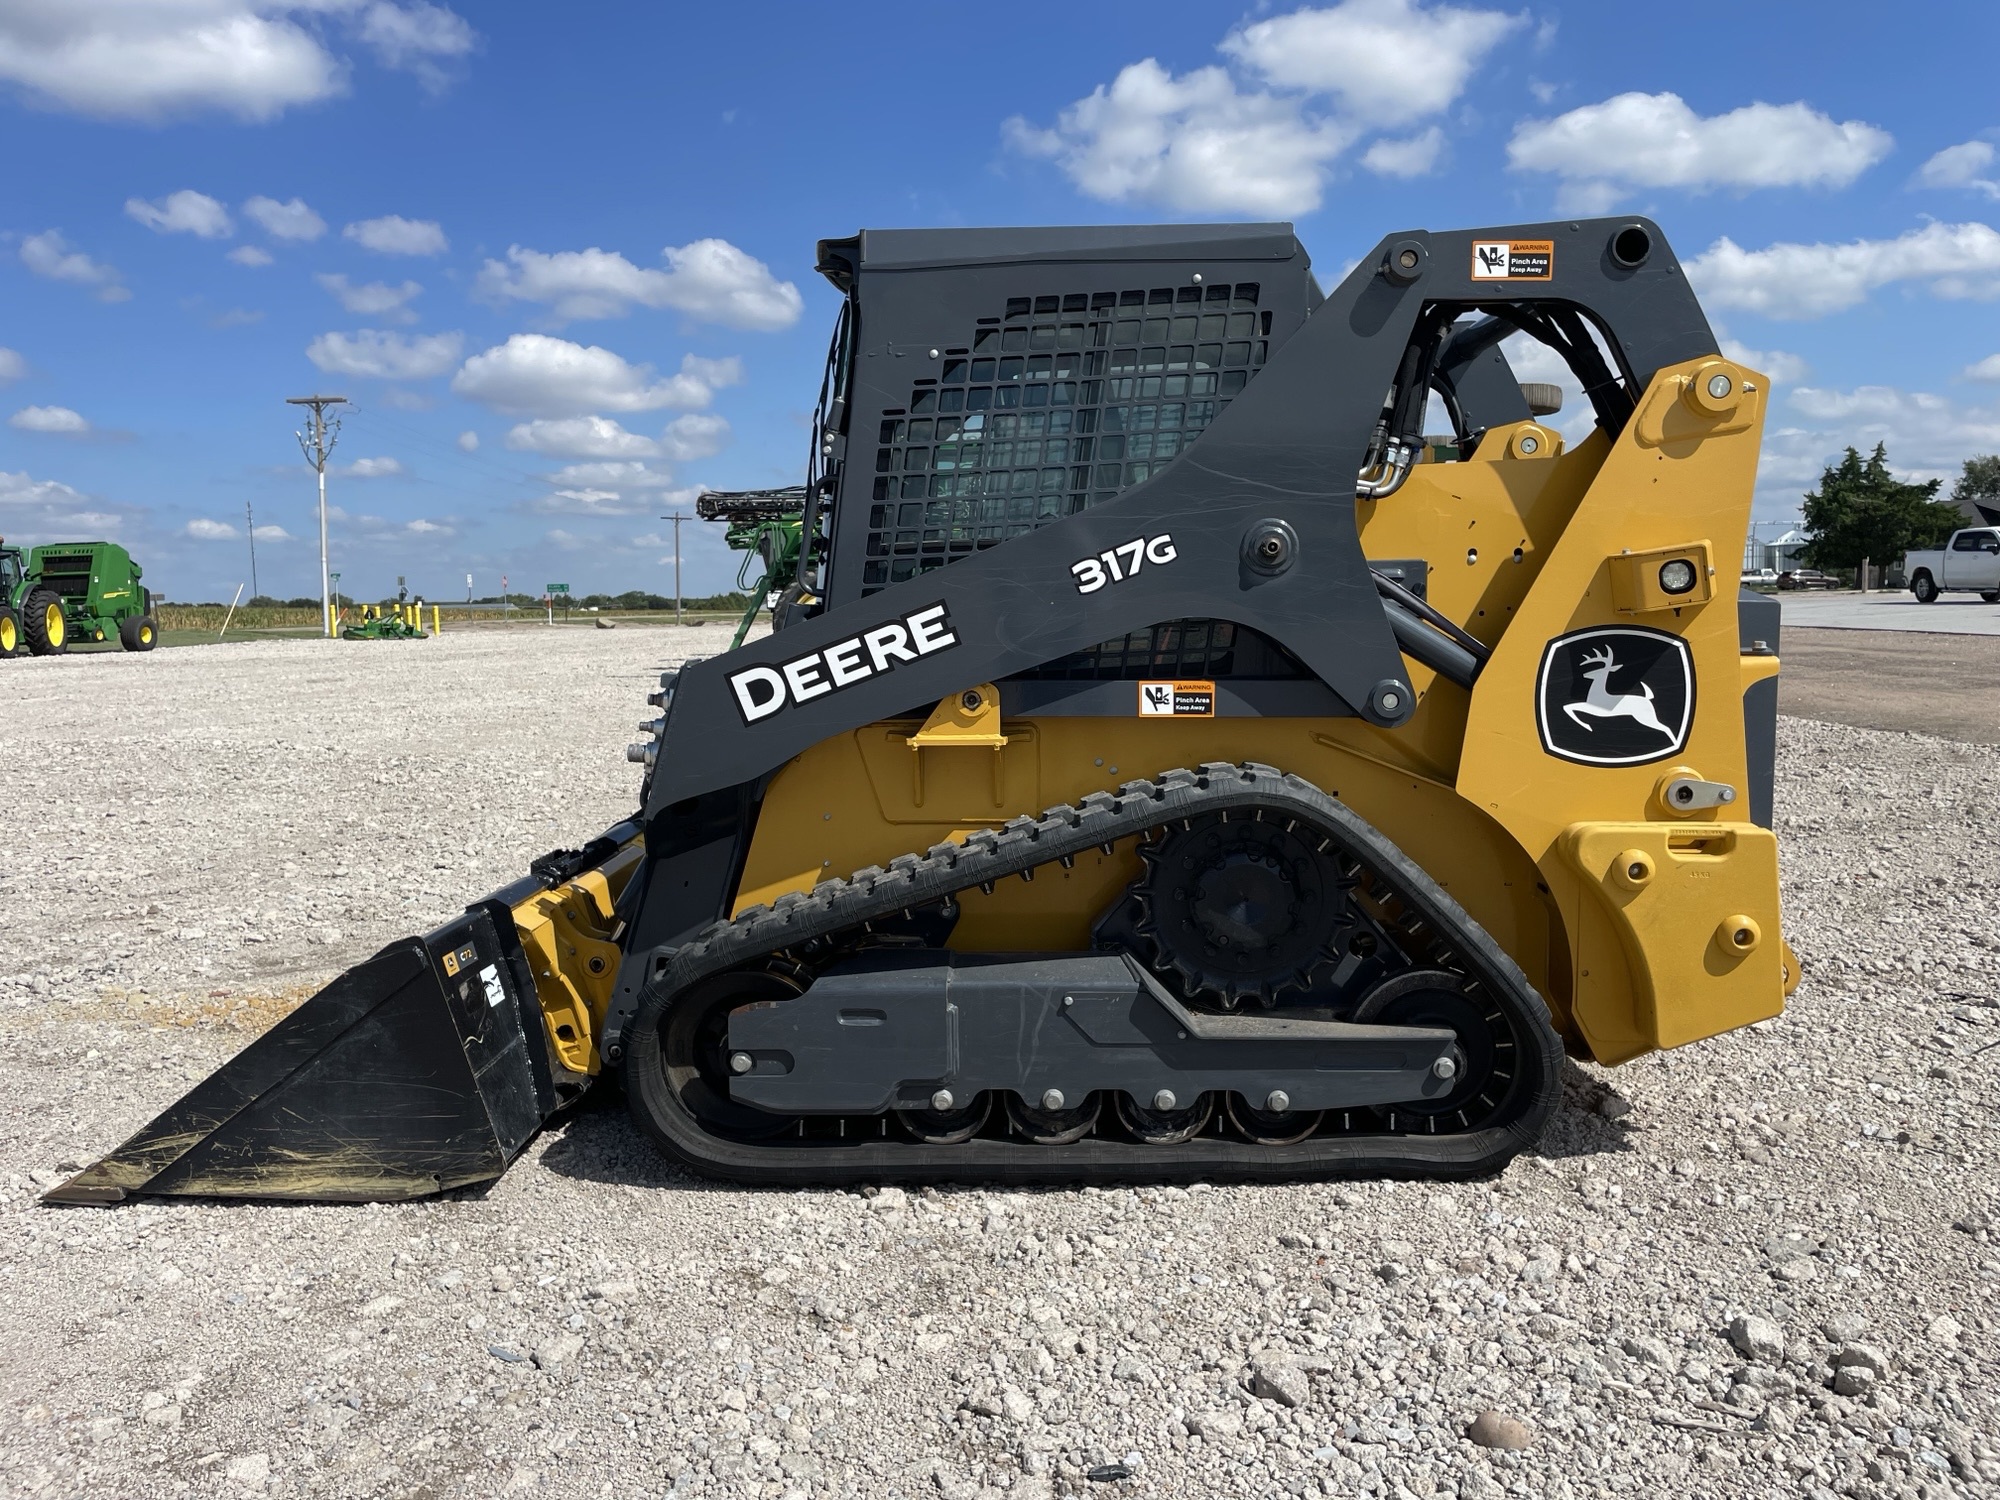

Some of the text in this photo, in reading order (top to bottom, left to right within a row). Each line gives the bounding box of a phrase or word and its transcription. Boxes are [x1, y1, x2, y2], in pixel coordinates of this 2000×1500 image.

[1071, 534, 1178, 594] 317G
[730, 604, 955, 723] DEERE
[460, 949, 472, 961] C72
